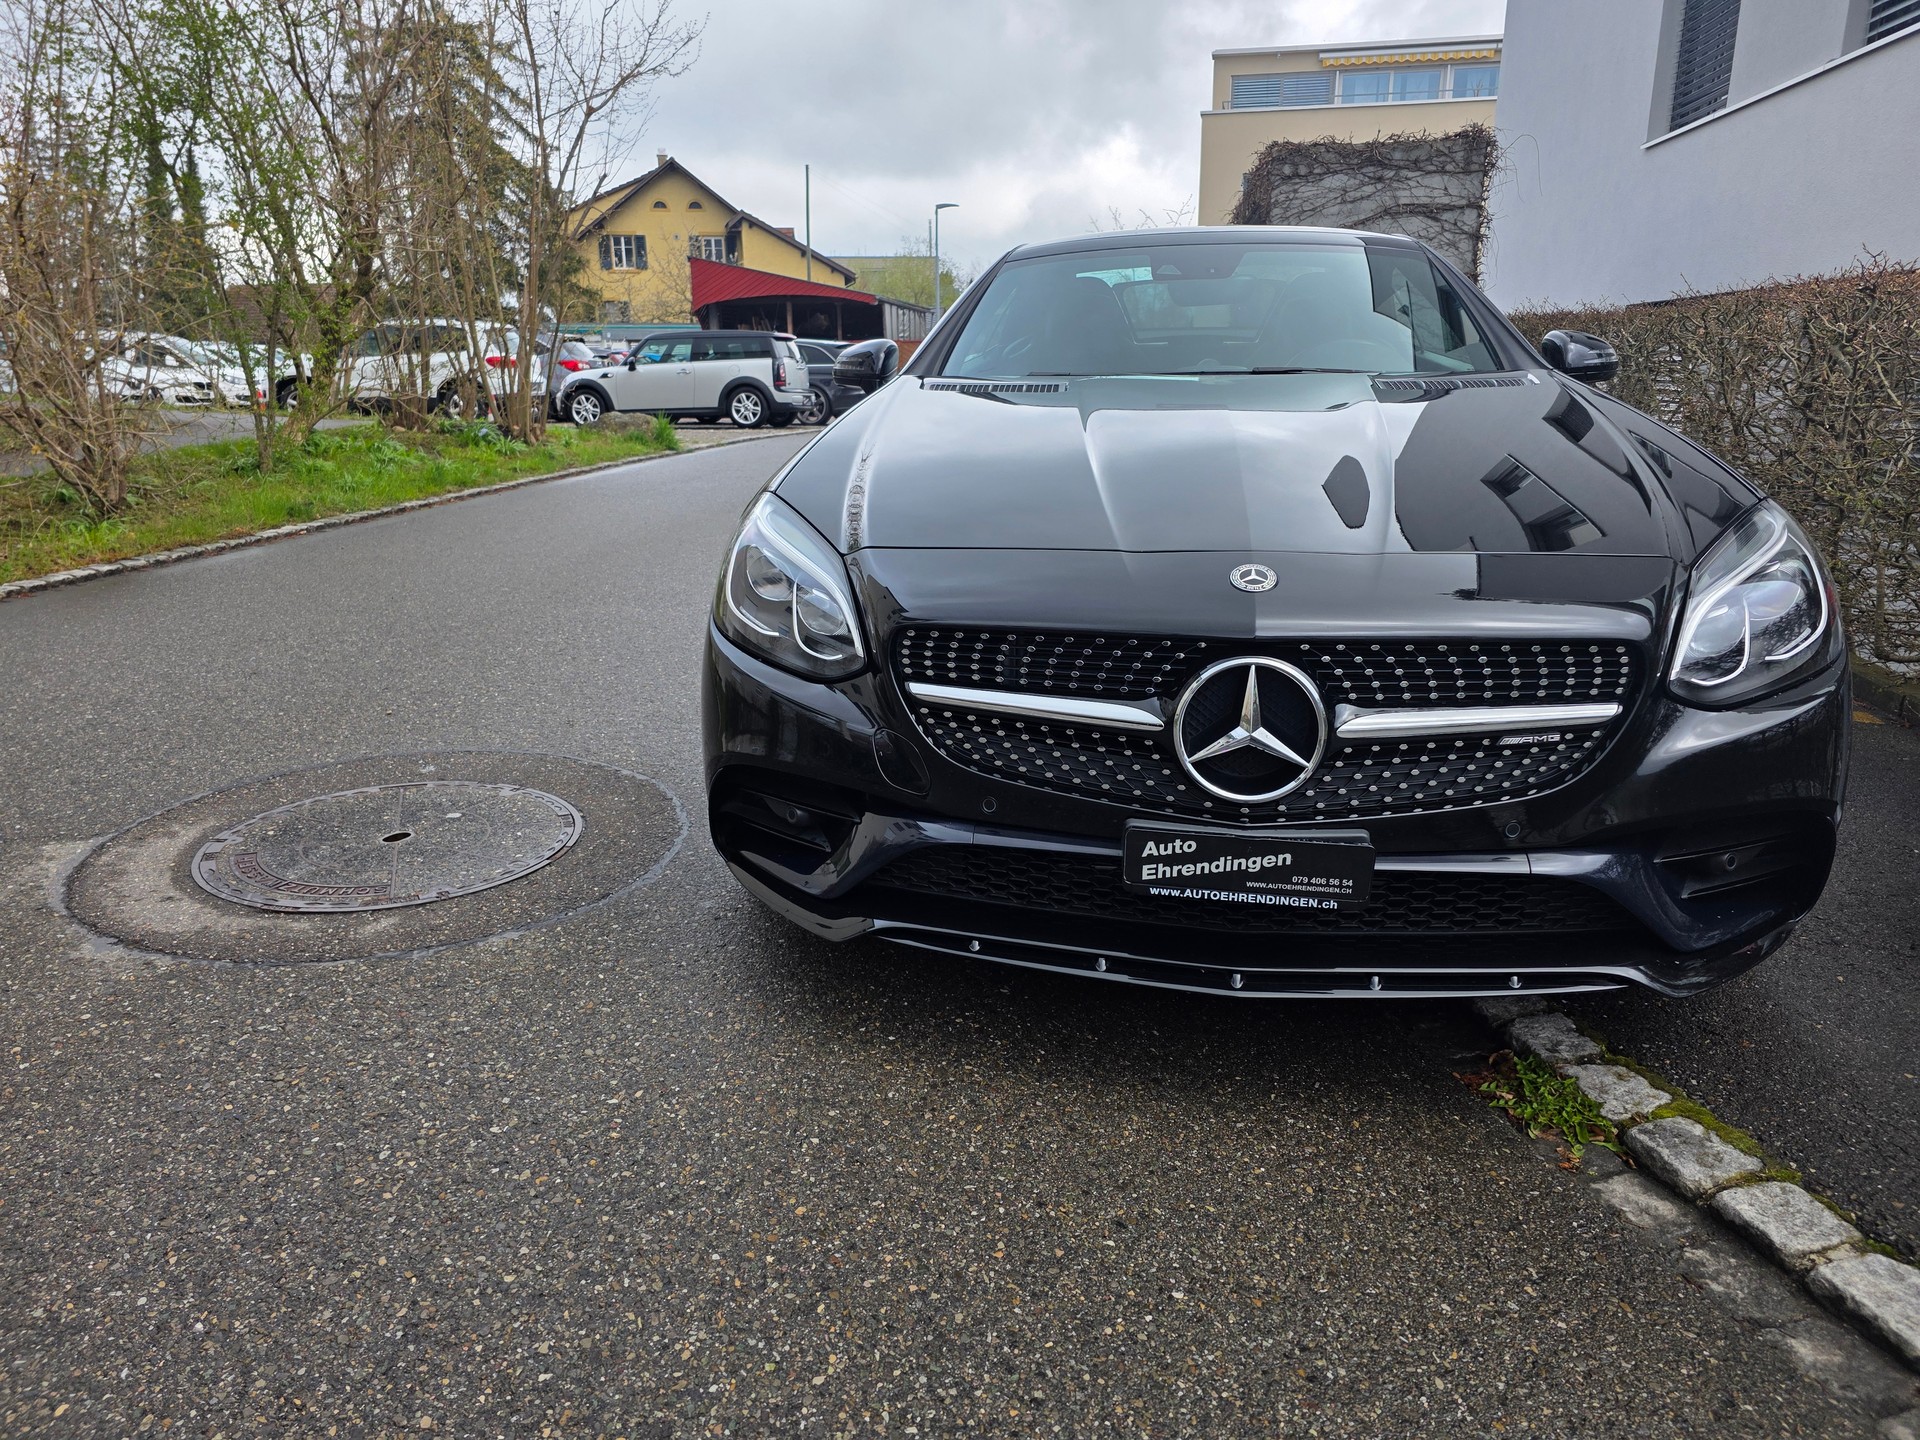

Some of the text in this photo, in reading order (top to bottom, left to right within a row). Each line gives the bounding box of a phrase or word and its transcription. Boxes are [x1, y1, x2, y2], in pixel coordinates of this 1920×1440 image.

[1518, 734, 1561, 744] AMG
[1141, 838, 1197, 858] Auto
[1141, 852, 1292, 880] Ehrendingen
[1246, 881, 1352, 894] WWW.AUTOEHRENDINGEN.CH
[1292, 875, 1353, 887] 079 406 56 54
[1150, 887, 1338, 909] www.AUTOEHRENDINGEN.ch
